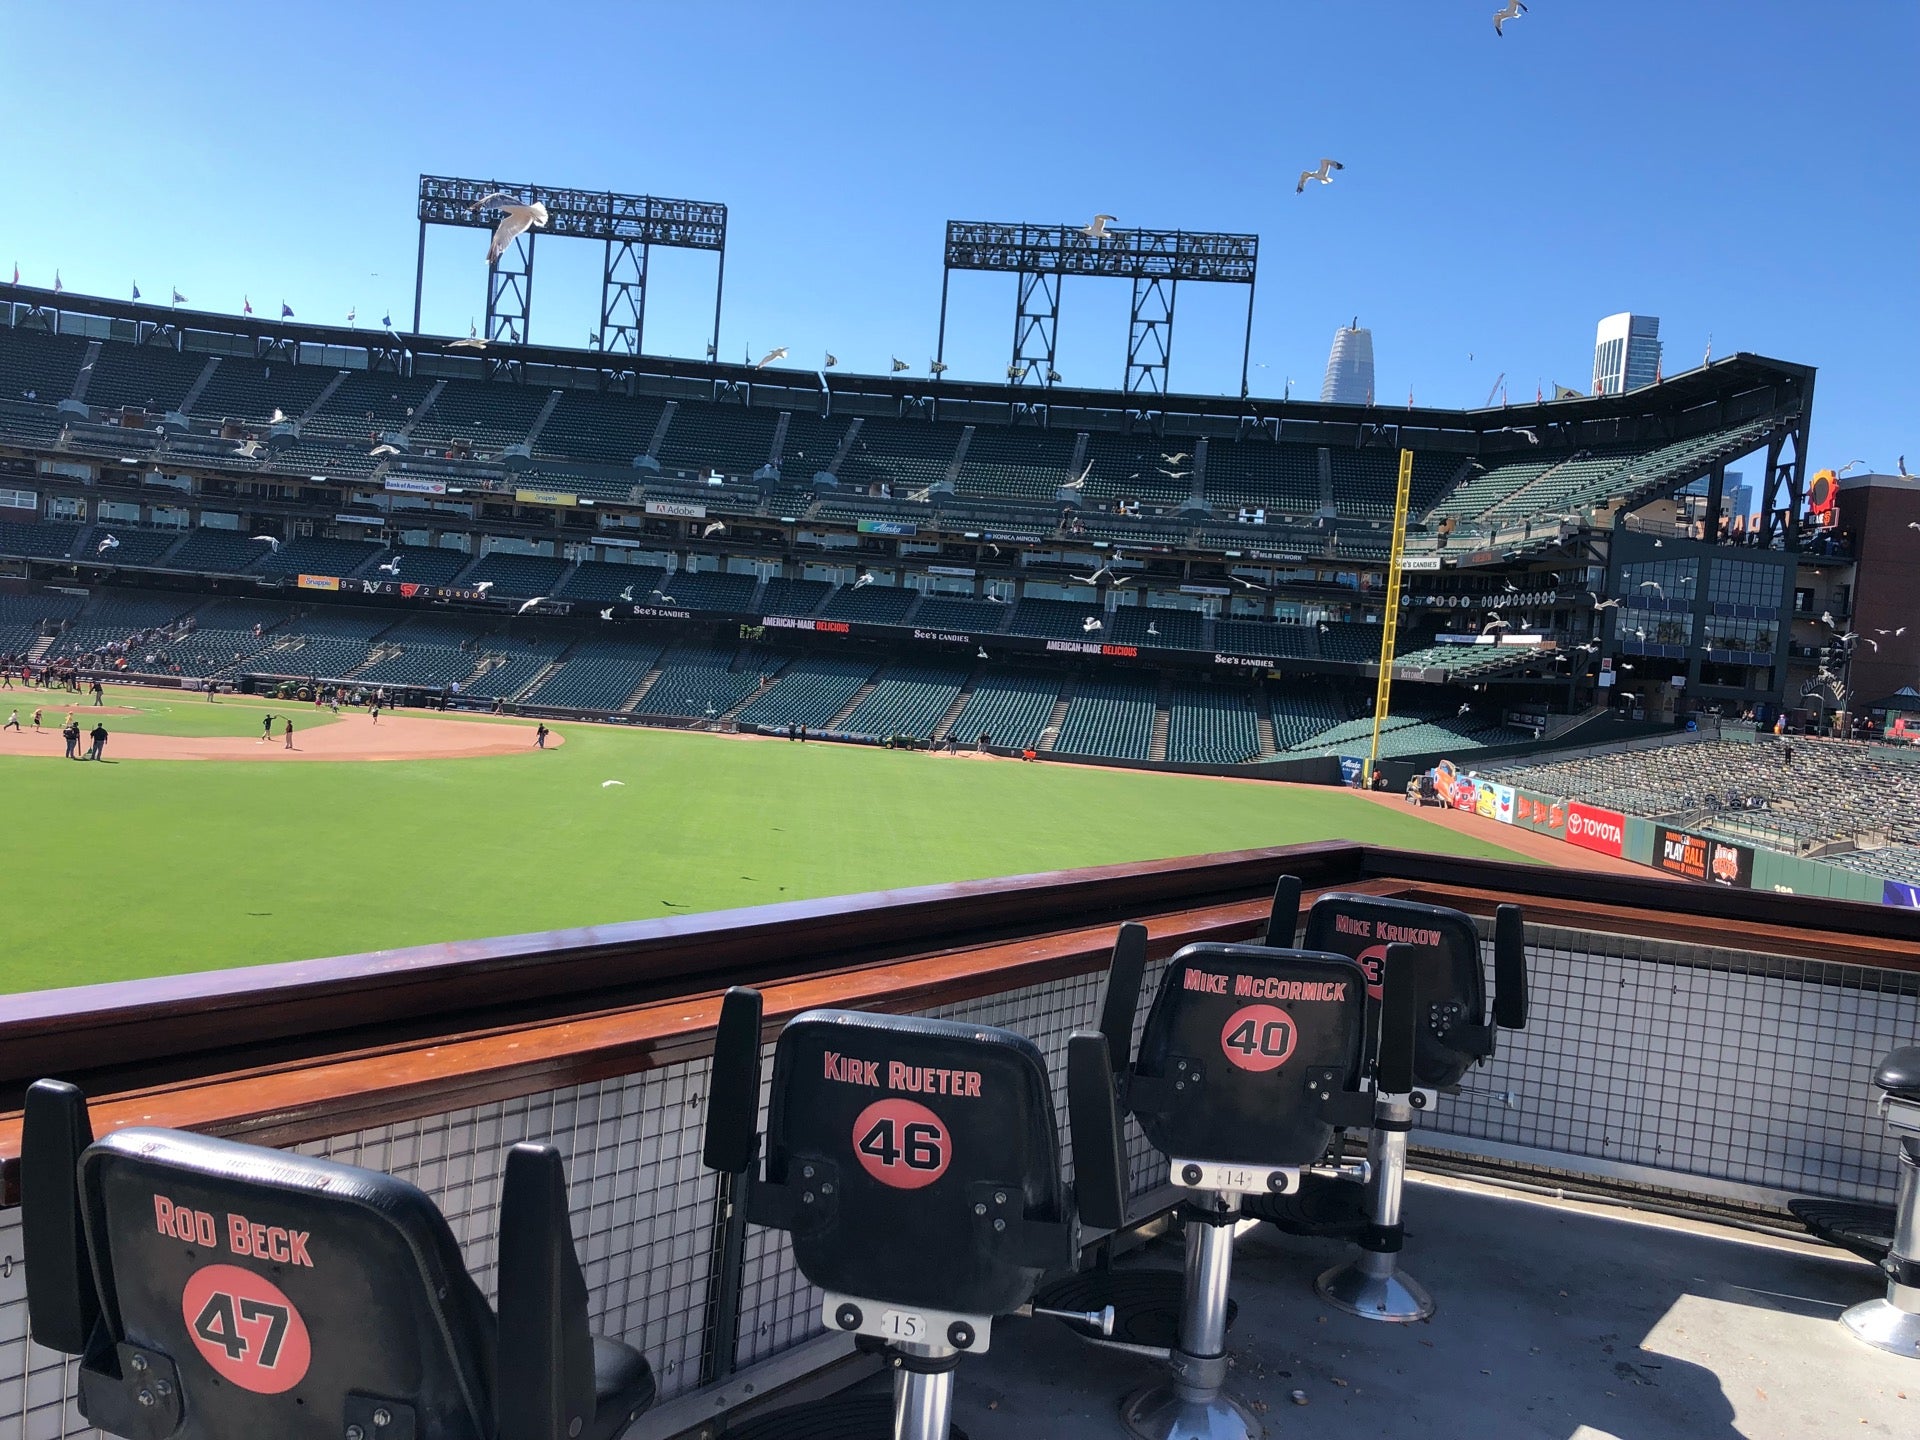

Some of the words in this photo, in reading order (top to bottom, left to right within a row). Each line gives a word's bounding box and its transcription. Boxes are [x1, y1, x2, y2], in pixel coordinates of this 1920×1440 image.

[386, 480, 400, 489] Bank
[406, 483, 430, 492] America
[667, 505, 695, 516] Adobe
[873, 523, 902, 534] Alaska
[992, 533, 1015, 542] KONICA
[1260, 552, 1272, 560] MLB
[1273, 553, 1302, 561] NETWORK
[305, 577, 332, 587] Snapple
[341, 581, 347, 589] 9
[386, 584, 392, 592] 6
[424, 588, 430, 596] 2
[446, 589, 451, 597] 0
[464, 590, 470, 598] 0
[480, 592, 486, 600] 3
[633, 606, 657, 616] See's
[658, 609, 690, 619] CANDIES
[762, 616, 816, 630] AMERICAN-MADE
[816, 621, 850, 633] DELICIOUS
[914, 630, 937, 640] See's
[938, 633, 970, 642] CANDIES
[1046, 640, 1102, 654] AMERICAN-MADE
[1102, 645, 1138, 658] DELICIOUS
[1214, 654, 1239, 666] See's
[1240, 658, 1274, 668] CANDIES
[1342, 759, 1361, 769] Alaska
[1583, 818, 1622, 844] TOYOTA
[1664, 840, 1684, 862] PLAY
[1684, 845, 1704, 868] BALL
[1362, 955, 1384, 986] 3
[1225, 1019, 1291, 1057] 40
[858, 1118, 943, 1172] 46
[1226, 1170, 1245, 1186] 14
[192, 1290, 290, 1370] 47
[892, 1315, 916, 1337] 15
